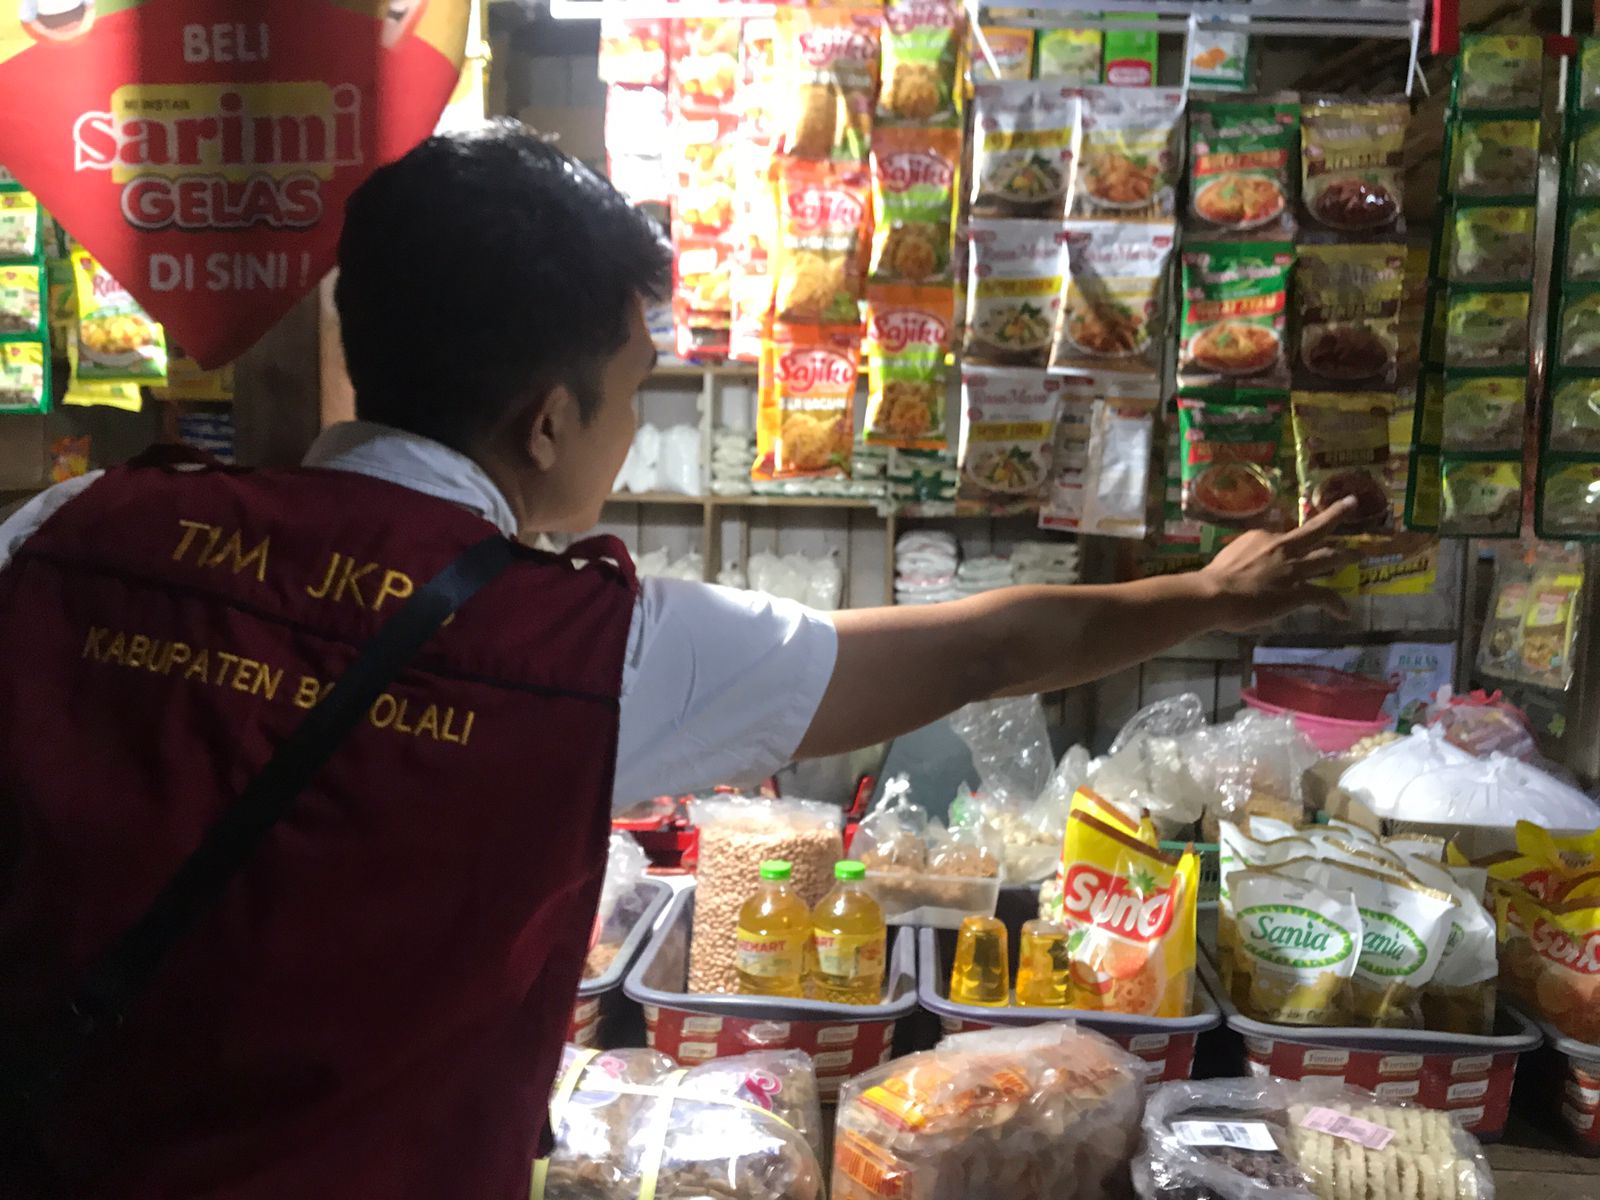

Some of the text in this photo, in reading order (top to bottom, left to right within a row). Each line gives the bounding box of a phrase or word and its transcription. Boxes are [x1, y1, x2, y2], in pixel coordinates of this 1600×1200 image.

[183, 24, 269, 62] BELI
[72, 83, 364, 171] Sarimi
[121, 174, 324, 232] GELAS
[150, 254, 194, 290] DI
[206, 254, 287, 289] SINI
[171, 520, 270, 582] TIM
[82, 626, 475, 747] KABUPATEN BOLALI
[1250, 915, 1332, 952] Sania
